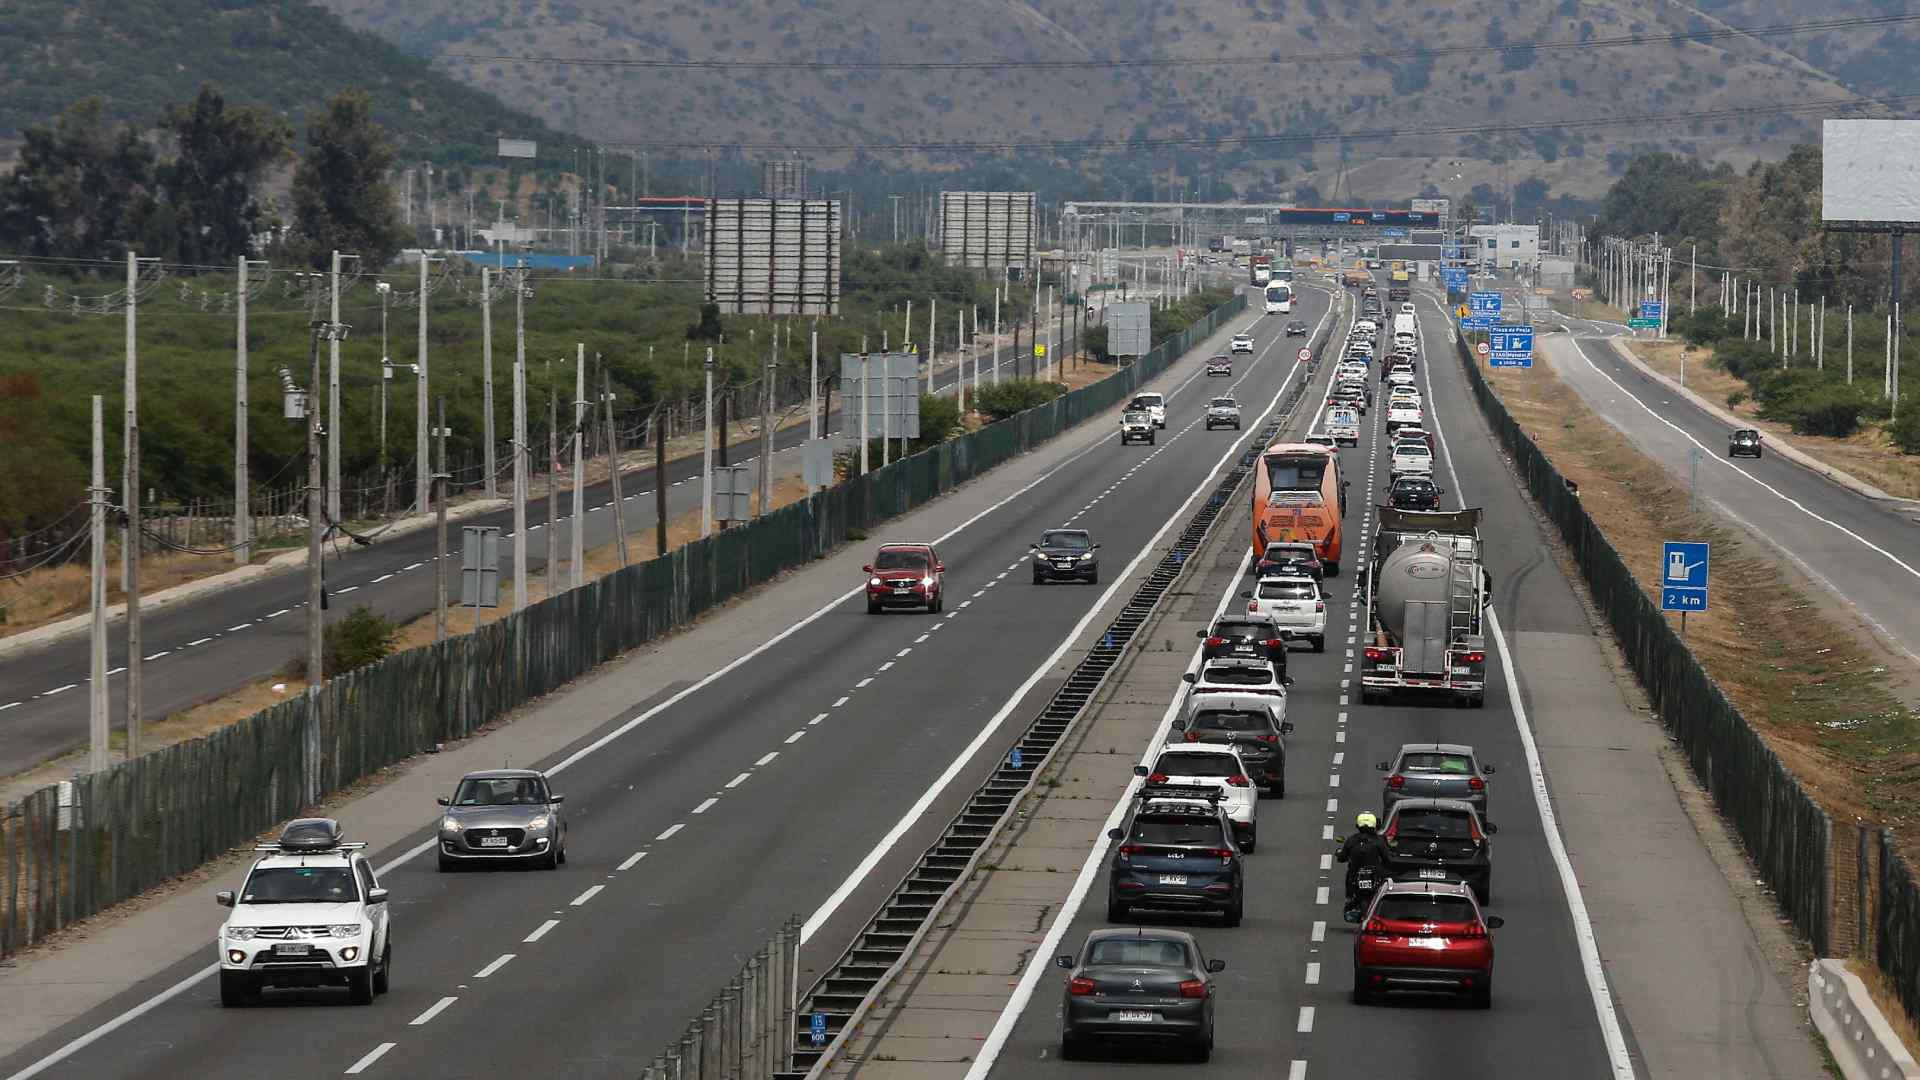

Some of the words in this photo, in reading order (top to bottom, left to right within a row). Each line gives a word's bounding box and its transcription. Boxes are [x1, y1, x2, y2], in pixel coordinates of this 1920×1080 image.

[1668, 594, 1676, 605] 2
[1682, 595, 1700, 605] km
[815, 1015, 823, 1026] 15
[811, 1033, 825, 1041] 600
